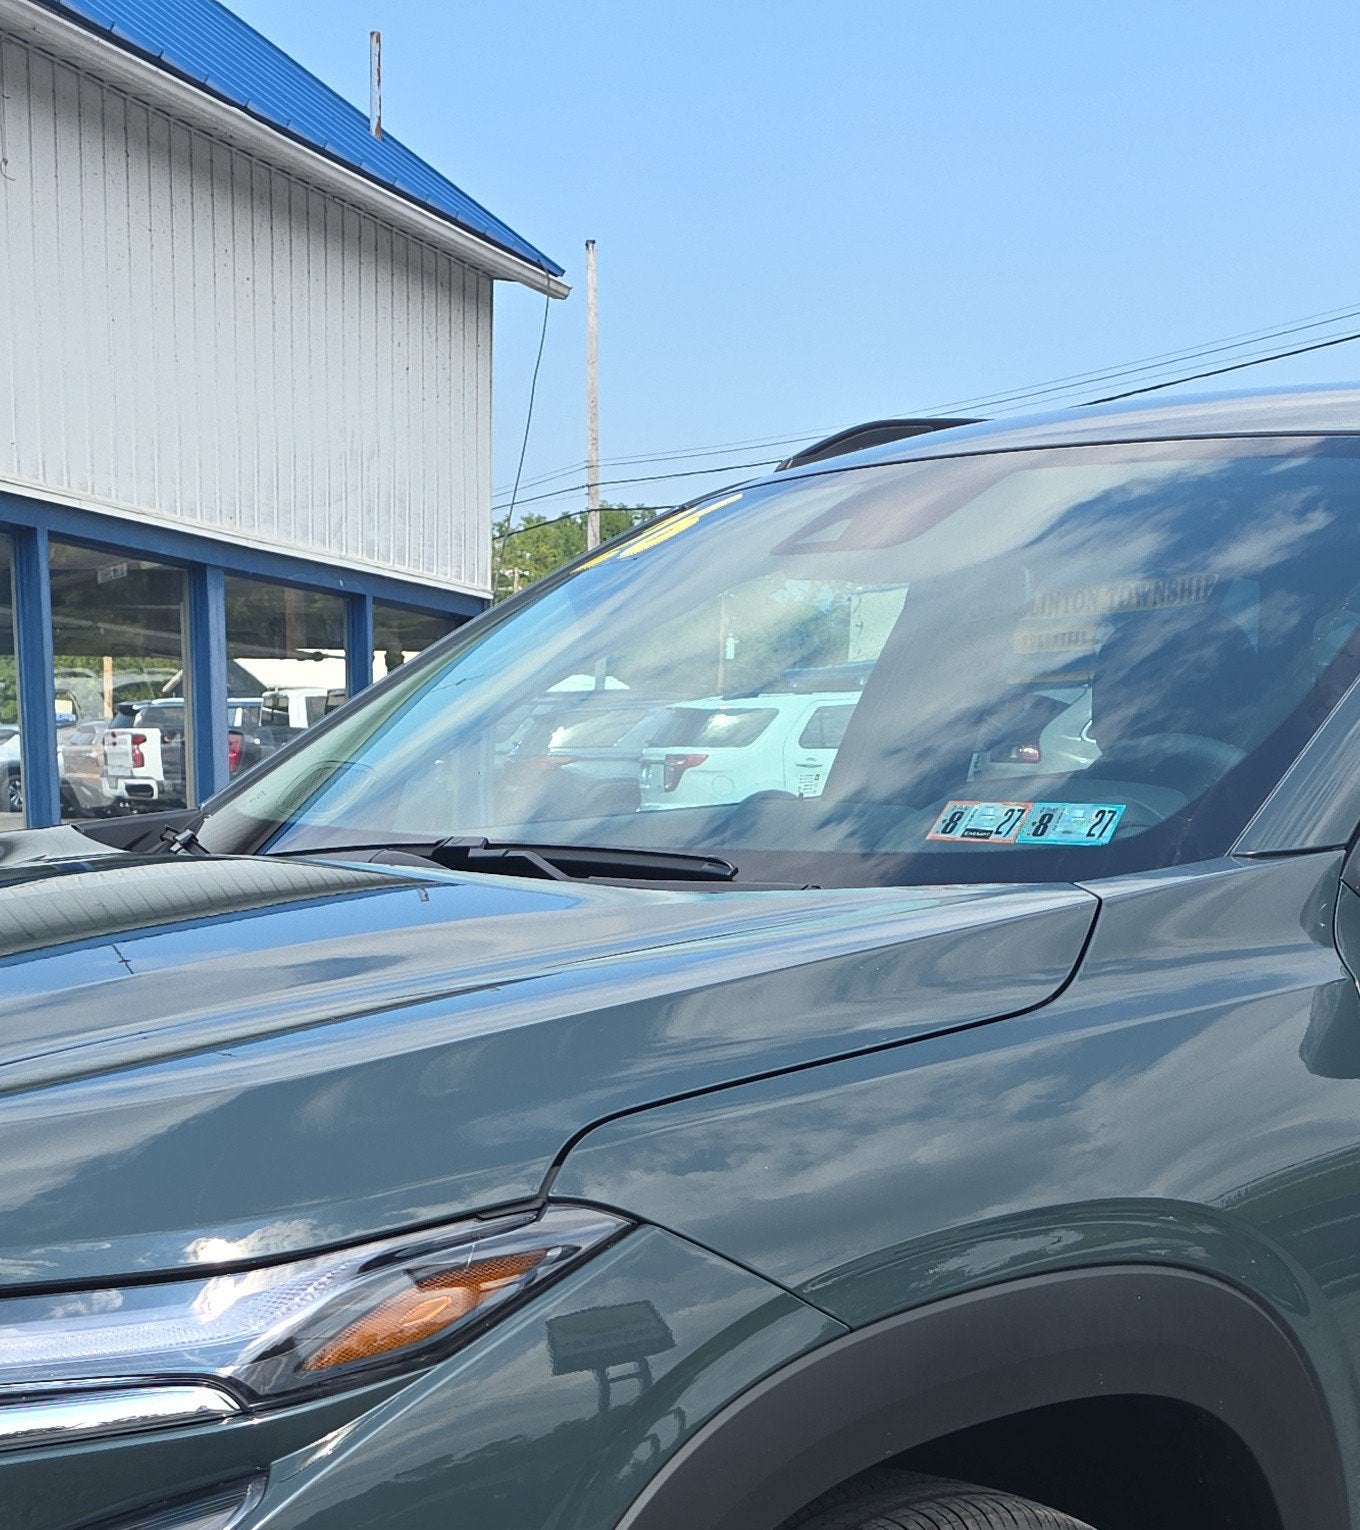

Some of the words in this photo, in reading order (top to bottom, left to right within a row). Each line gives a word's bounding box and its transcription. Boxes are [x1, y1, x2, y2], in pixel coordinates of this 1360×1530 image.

[941, 810, 965, 834] 8
[994, 808, 1026, 838] 27
[1032, 813, 1054, 837] 8
[1086, 809, 1117, 840] 27
